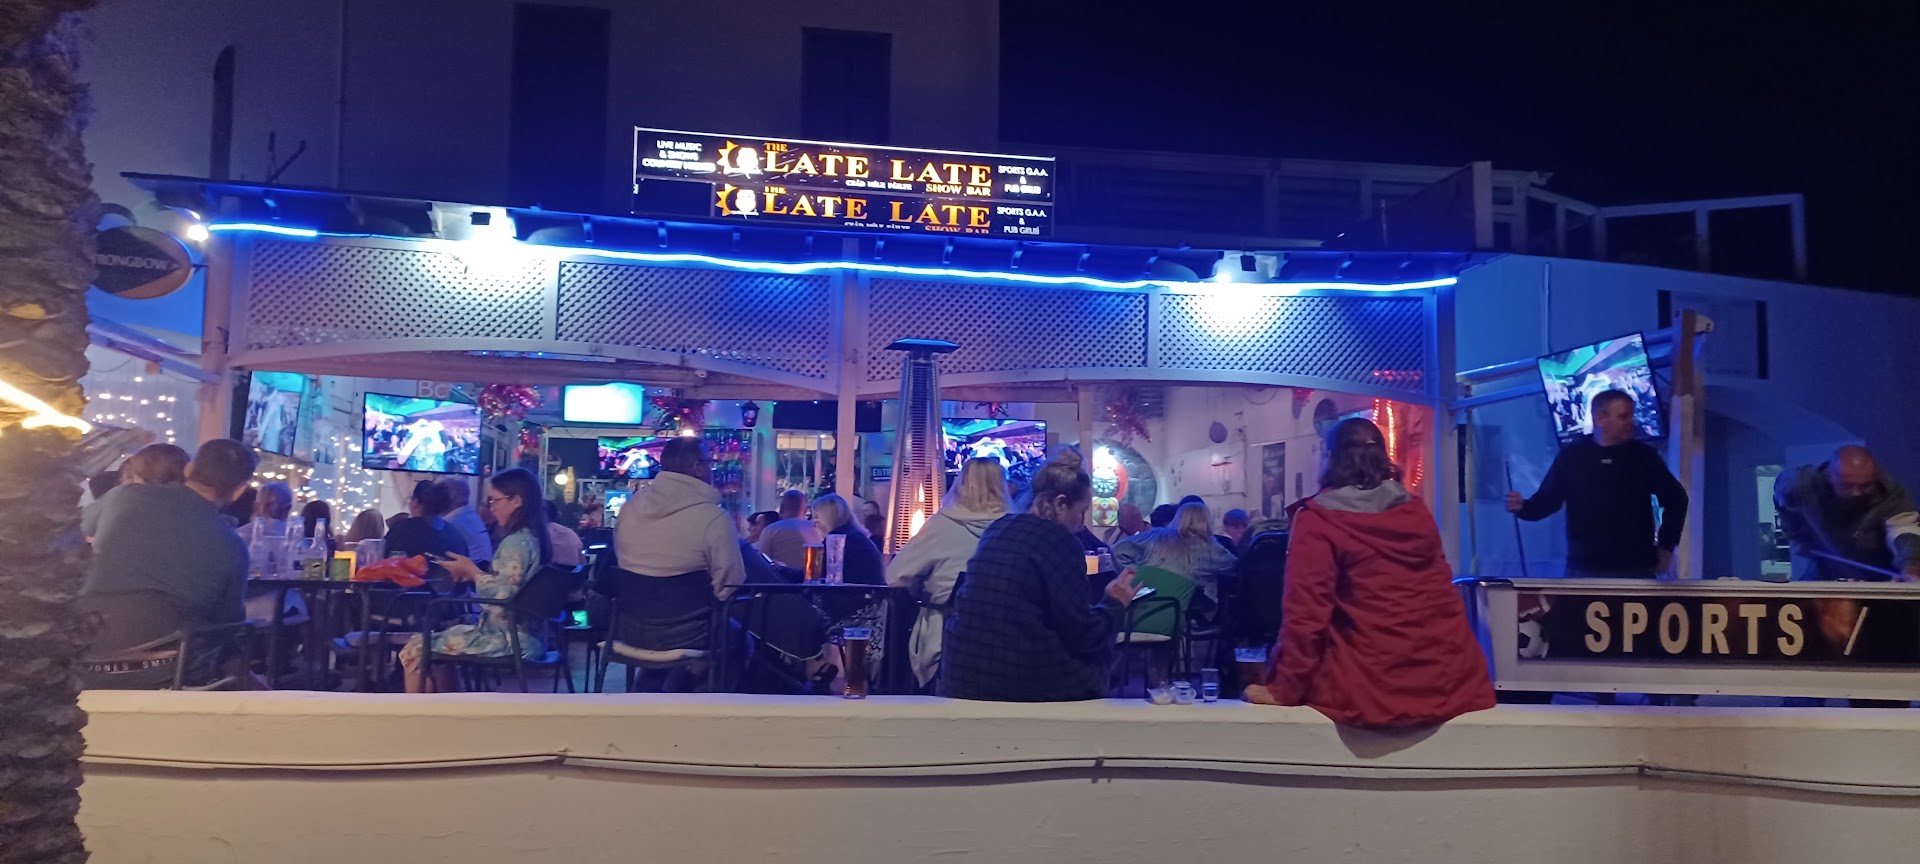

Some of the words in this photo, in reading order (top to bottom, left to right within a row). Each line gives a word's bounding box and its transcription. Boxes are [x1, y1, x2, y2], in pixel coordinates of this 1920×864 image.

[657, 140, 673, 149] LIVE
[675, 142, 702, 151] MUSIC
[764, 142, 788, 151] THE
[764, 150, 869, 179] LATE
[890, 159, 993, 187] LATE
[998, 165, 1025, 175] SPORTS
[925, 183, 962, 194] SHOW
[966, 186, 991, 197] BAR
[762, 192, 867, 219] LATE
[889, 200, 991, 228] LATE
[997, 206, 1024, 216] SPORTS
[1584, 601, 1804, 656] SPORTS
